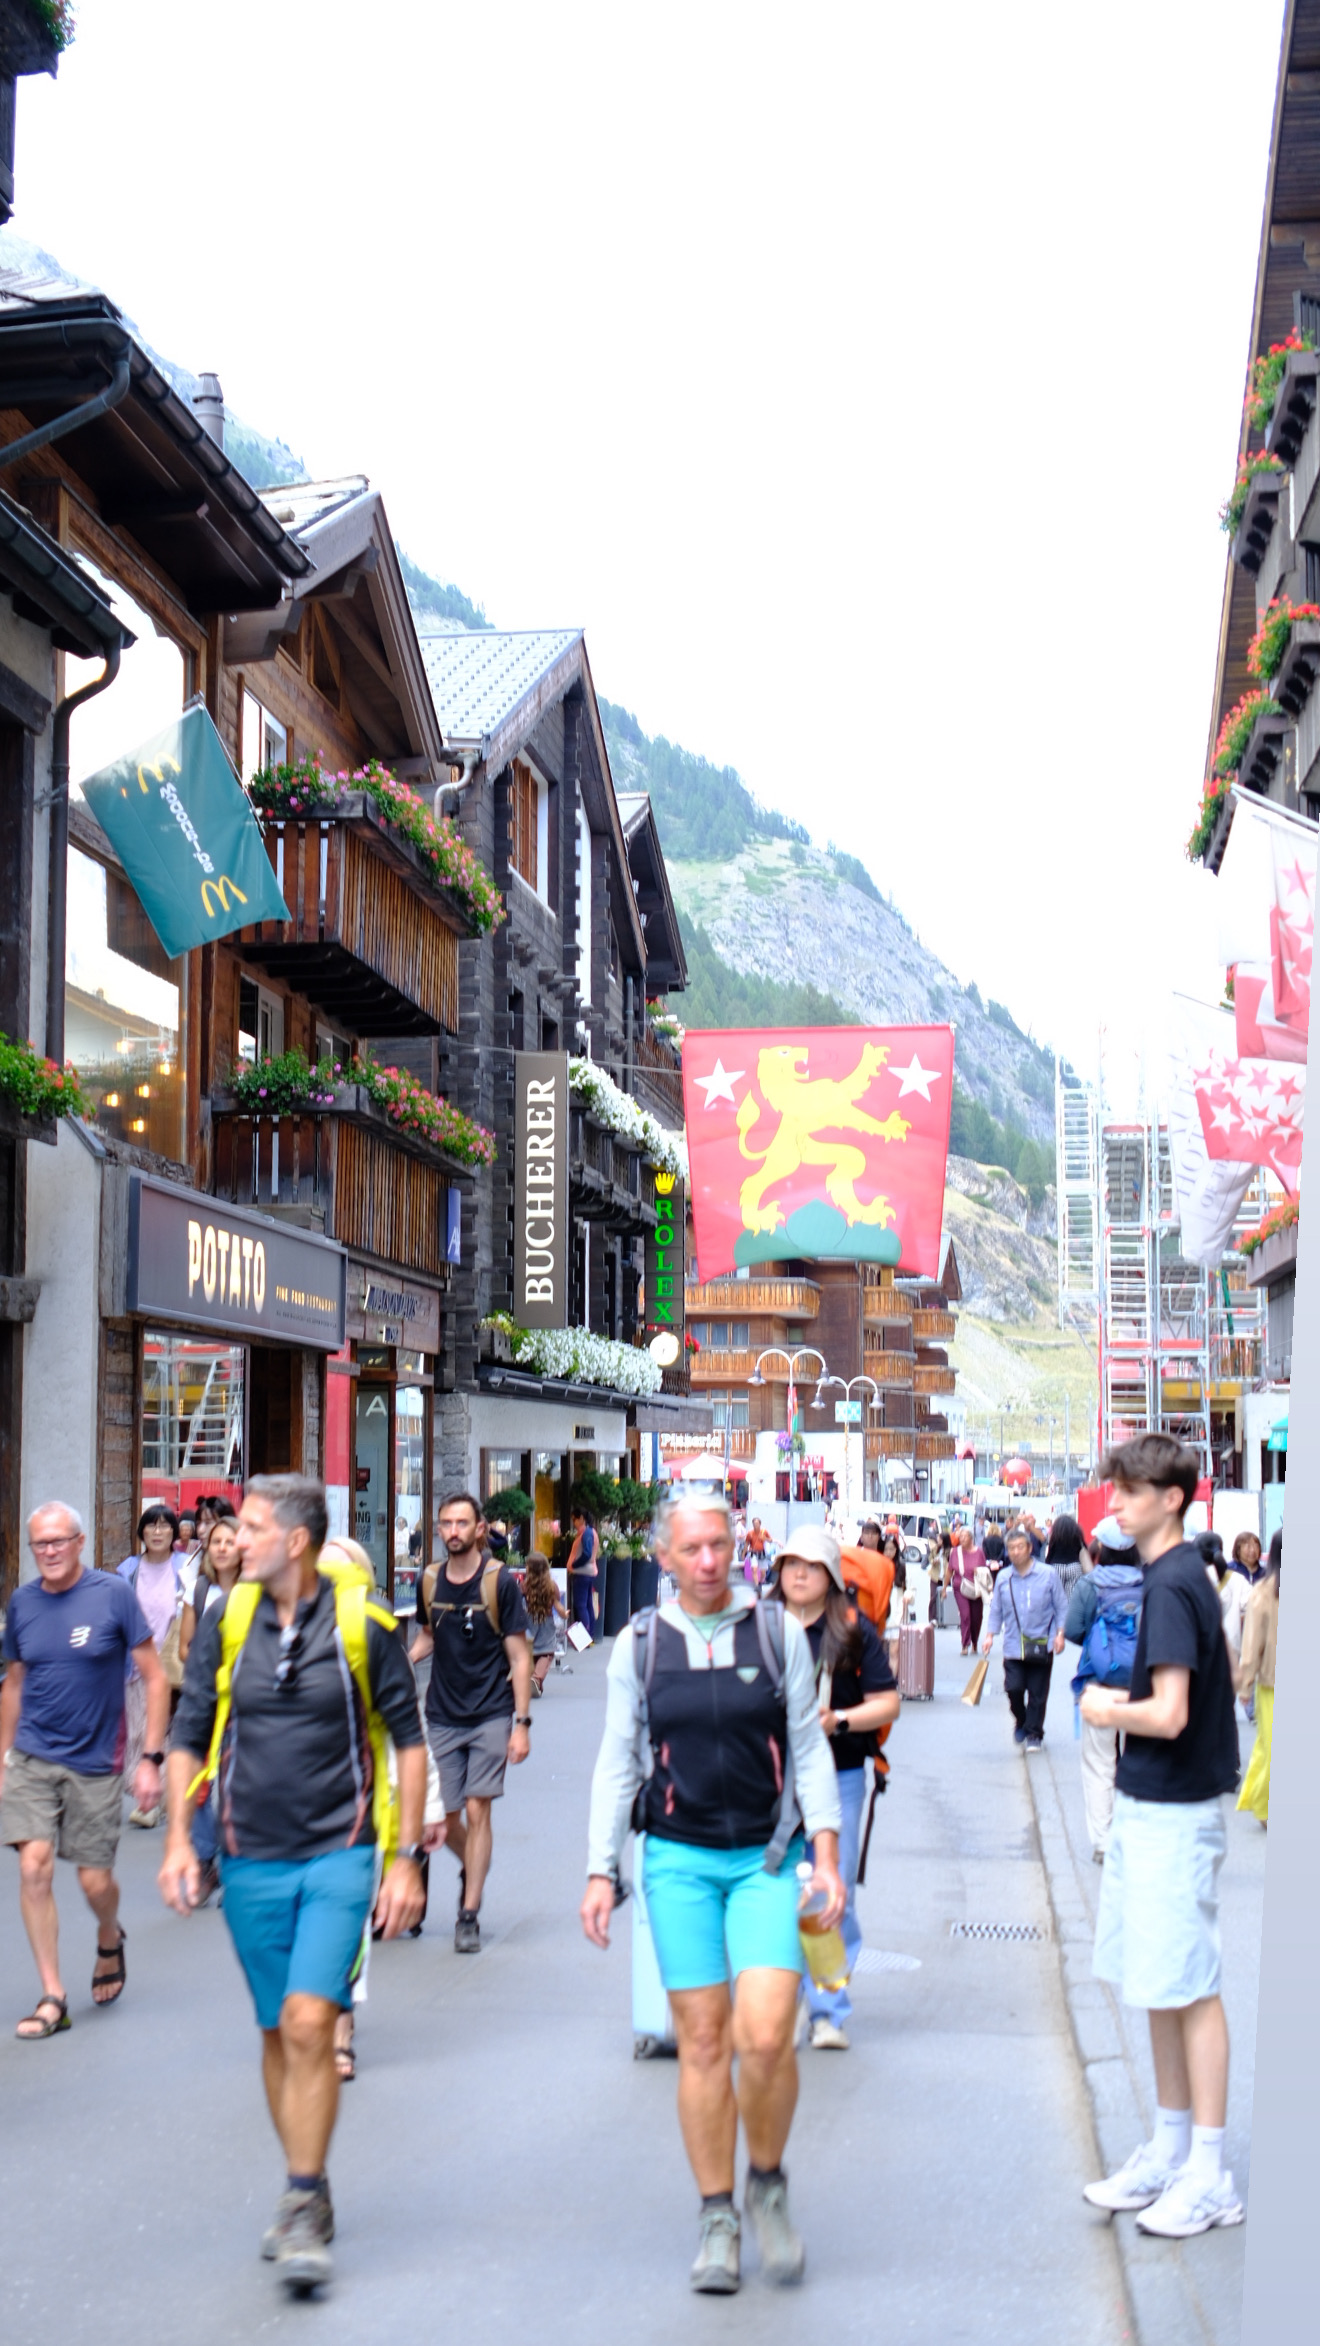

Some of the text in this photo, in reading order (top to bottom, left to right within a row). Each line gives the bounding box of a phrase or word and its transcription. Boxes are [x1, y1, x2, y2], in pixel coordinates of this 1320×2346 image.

[525, 1076, 556, 1304] BUCHERER
[188, 1220, 266, 1315] POTATO
[654, 1199, 675, 1323] ROLEX
[660, 1433, 722, 1449] Pizzeria
[803, 1456, 821, 1465] ATM
